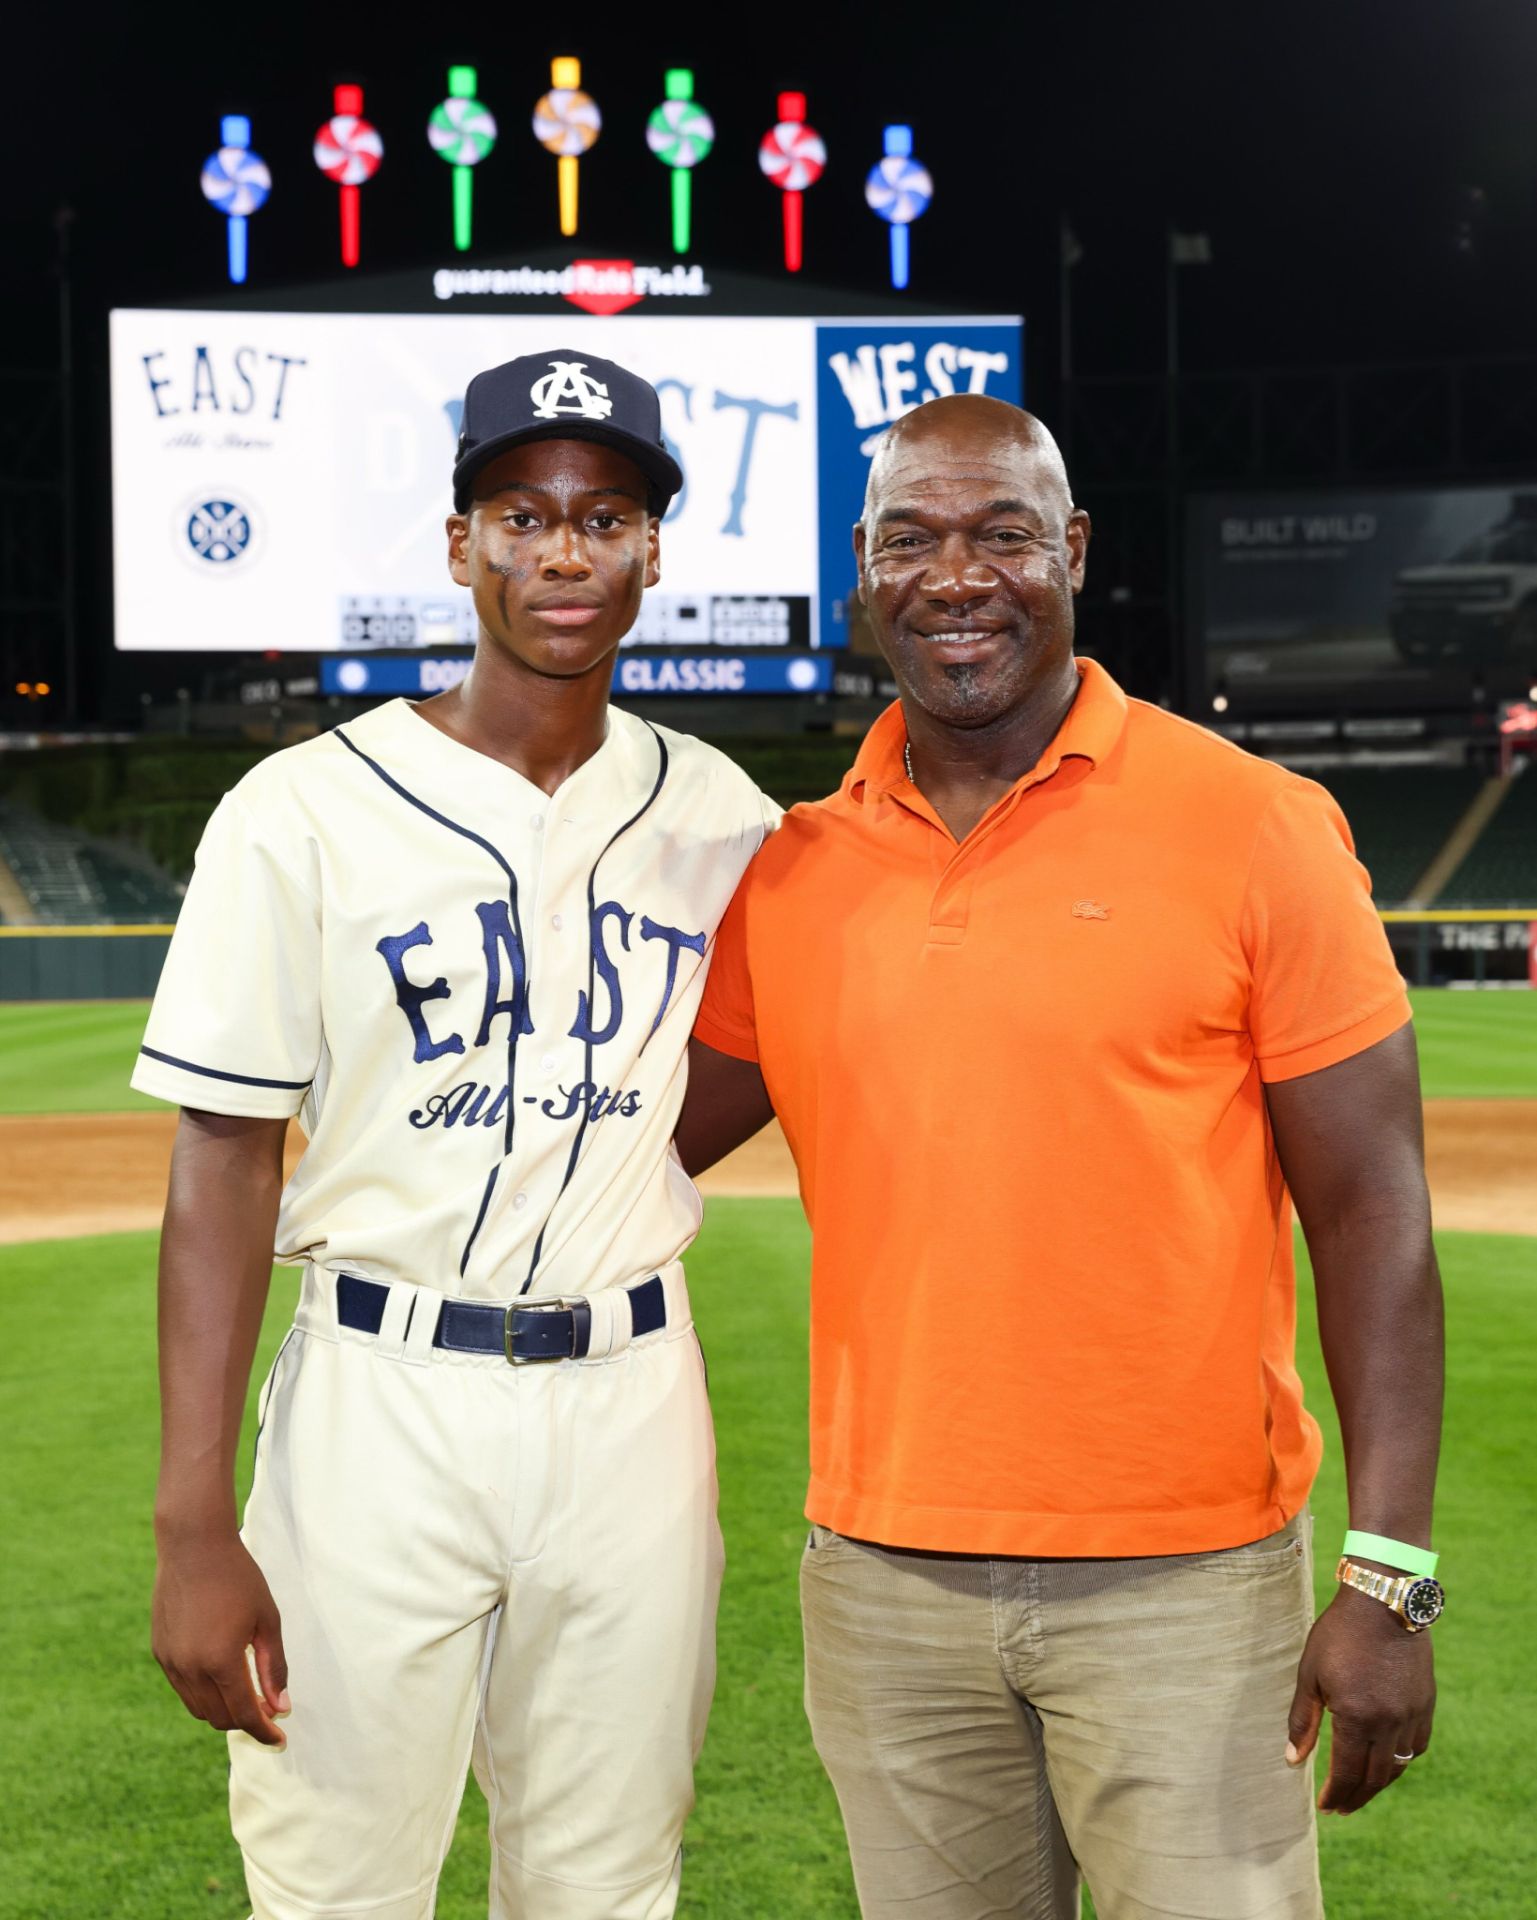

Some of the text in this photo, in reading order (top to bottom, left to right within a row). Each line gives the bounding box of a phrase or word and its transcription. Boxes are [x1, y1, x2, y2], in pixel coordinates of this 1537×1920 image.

[142, 345, 307, 421] EAST
[1221, 513, 1378, 546] BUILT WILD
[621, 658, 746, 691] CLASSIC
[376, 899, 706, 1064] EAST
